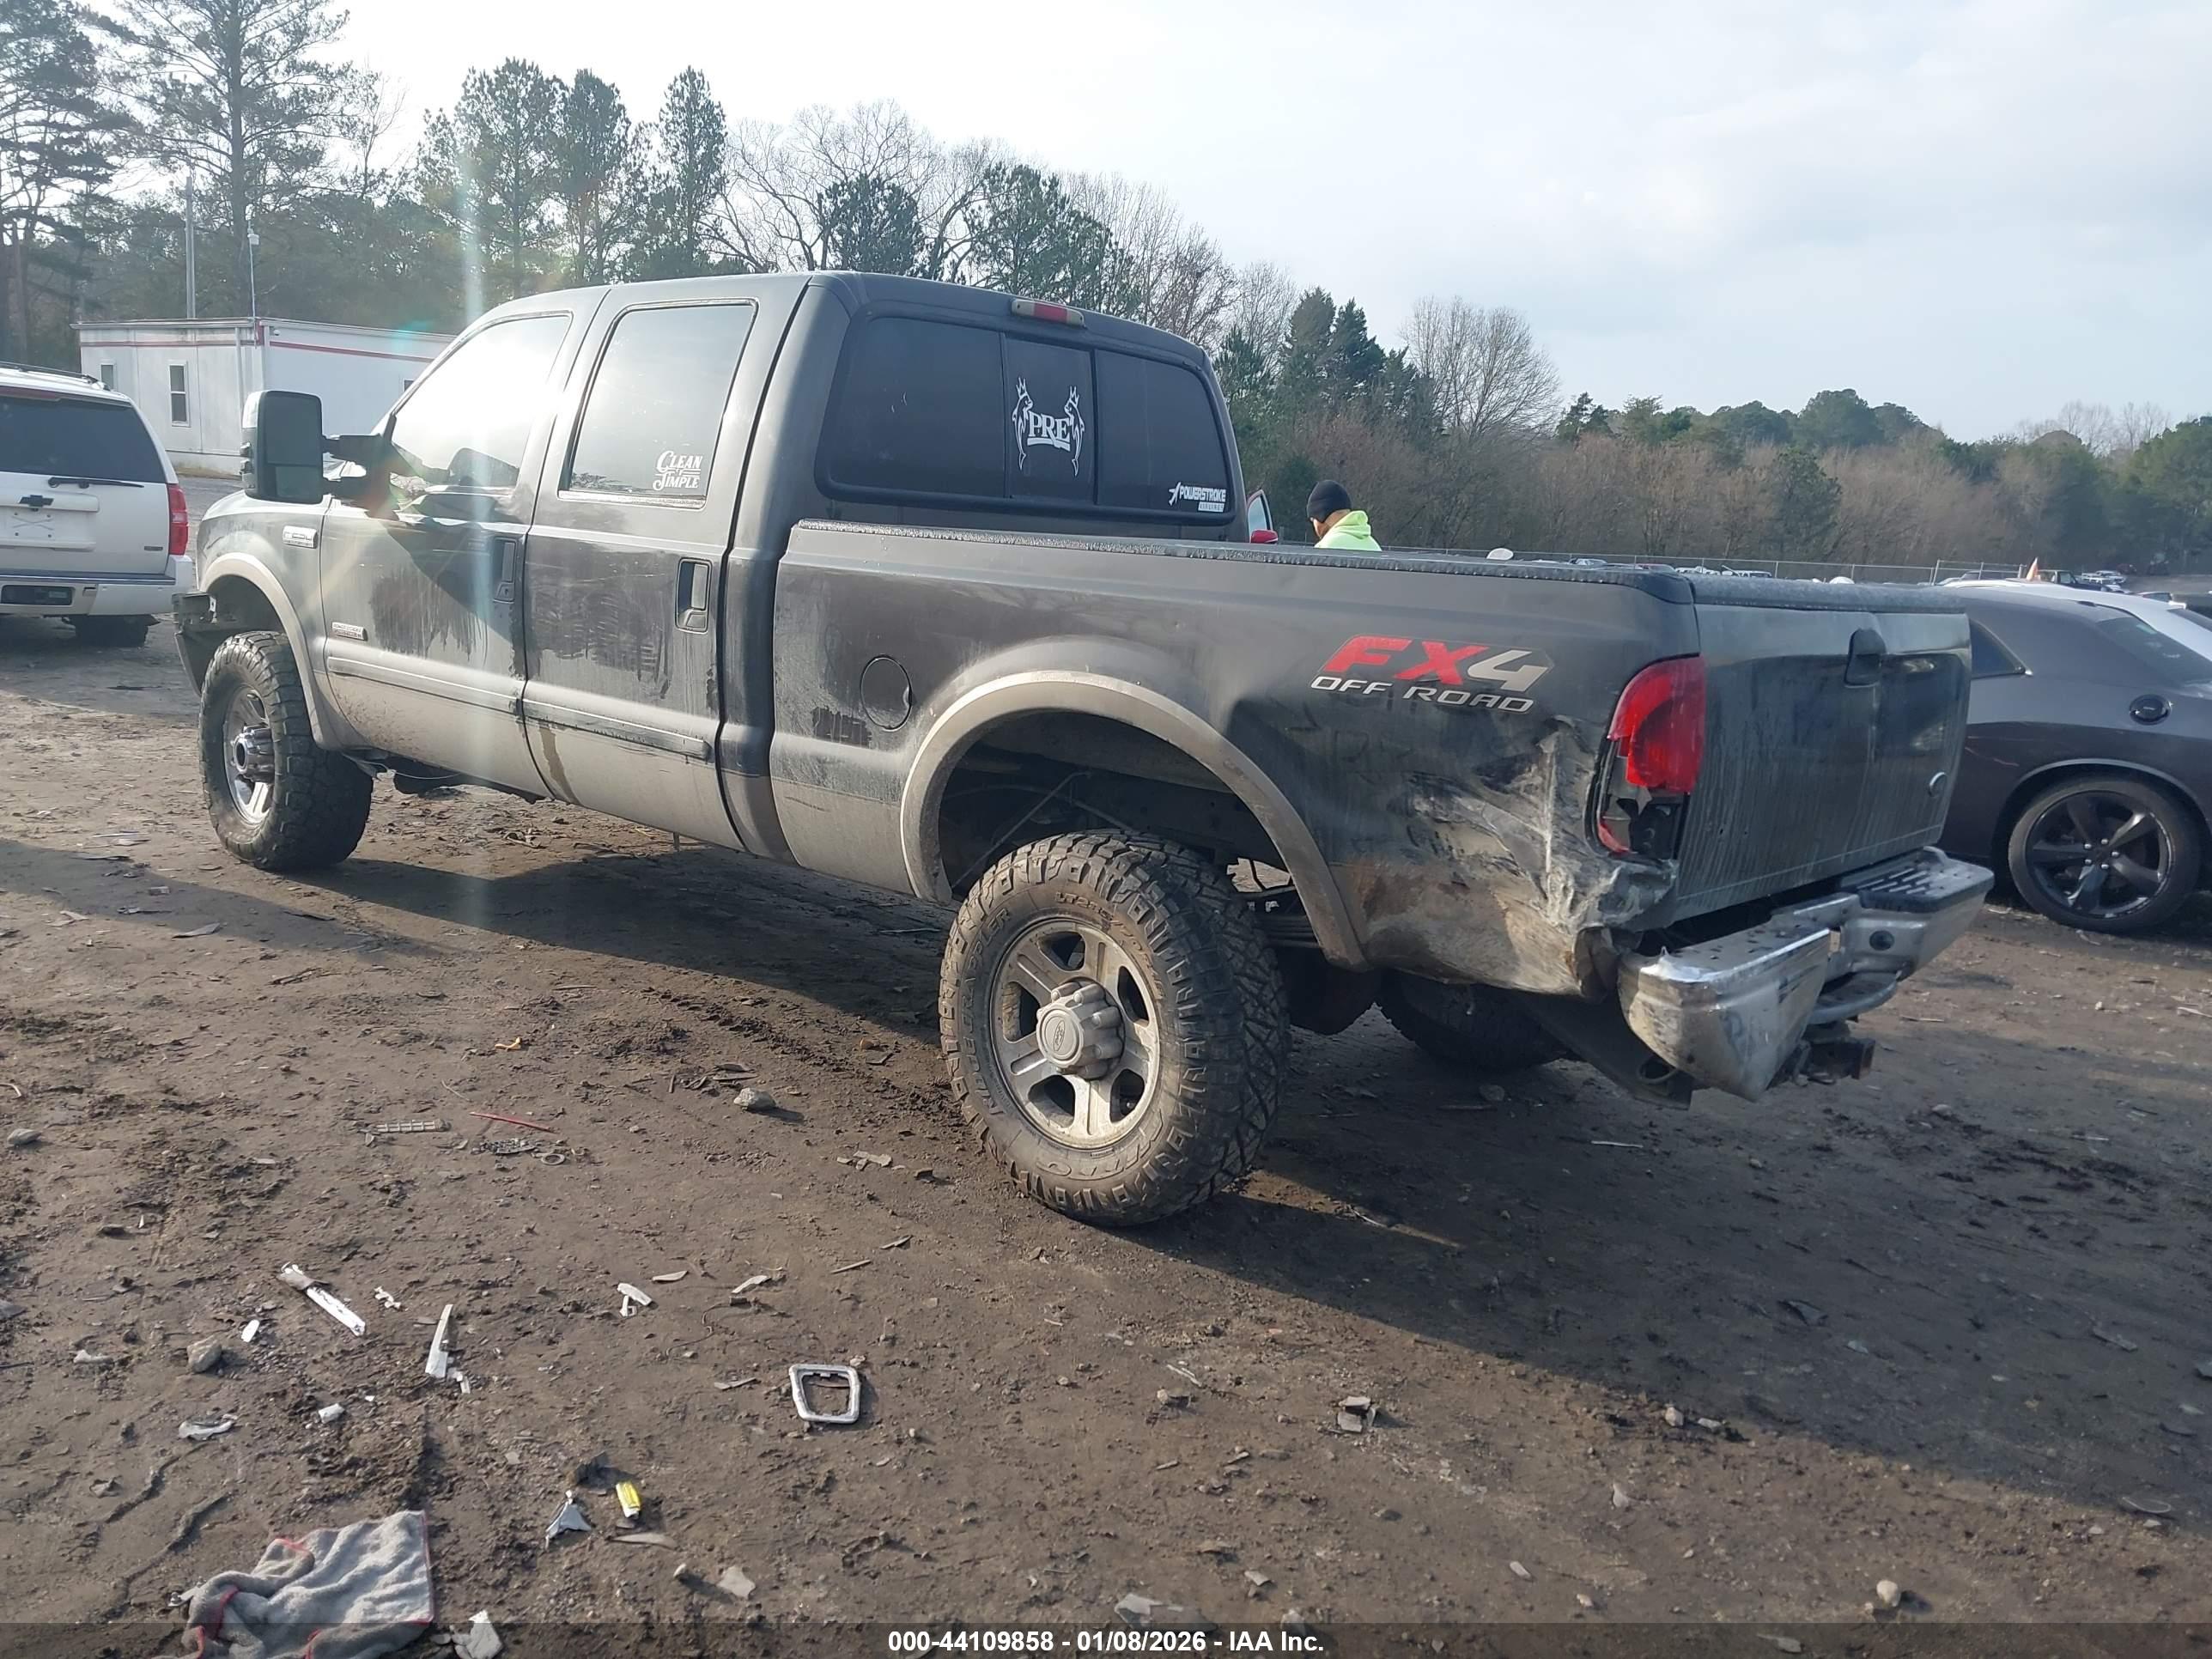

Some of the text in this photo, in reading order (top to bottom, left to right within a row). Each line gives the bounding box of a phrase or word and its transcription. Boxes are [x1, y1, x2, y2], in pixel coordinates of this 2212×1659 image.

[656, 451, 702, 472] CLEAN
[1179, 485, 1226, 501] POWERSTROKE
[1324, 635, 1548, 692] FX4
[1310, 676, 1534, 712] OFF ROAD
